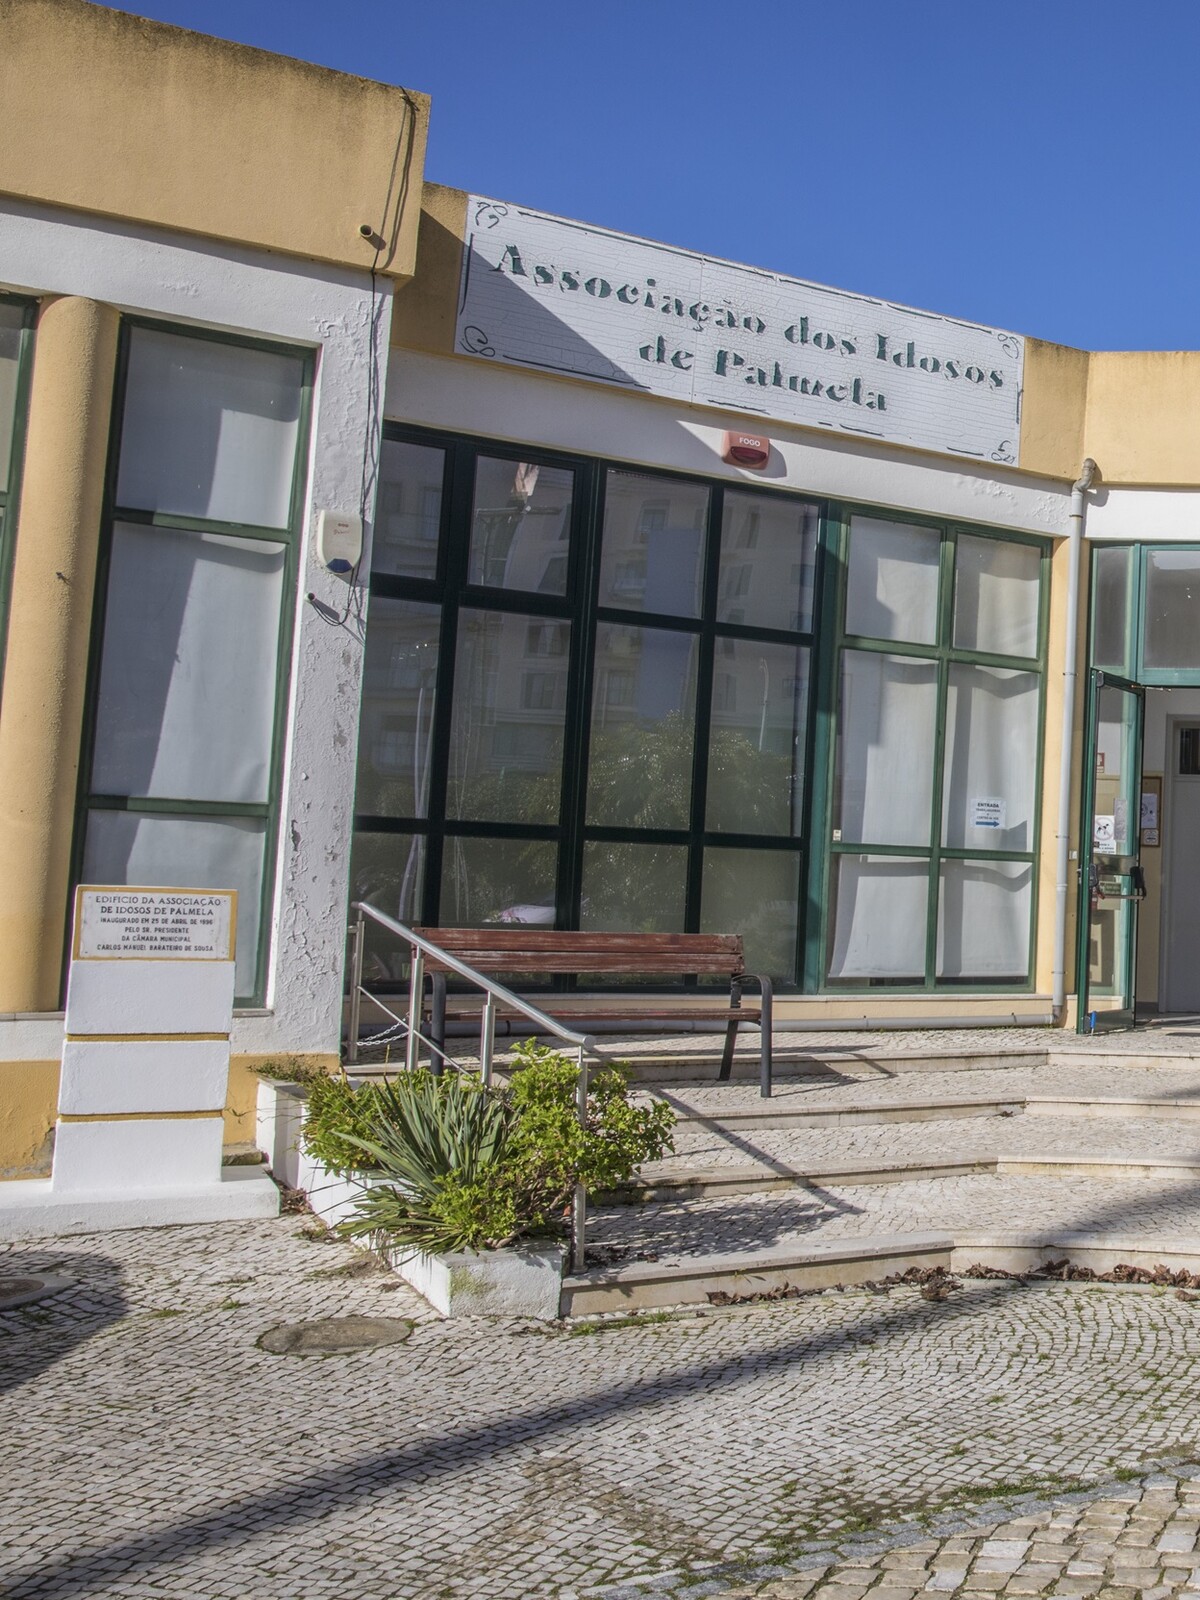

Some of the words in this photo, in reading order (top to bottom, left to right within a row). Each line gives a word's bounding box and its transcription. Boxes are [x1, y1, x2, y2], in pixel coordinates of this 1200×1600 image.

[488, 244, 767, 334] Associação
[784, 316, 857, 356] dos
[876, 333, 1004, 390] Idosos
[638, 334, 694, 371] de
[714, 349, 887, 411] Palmela
[739, 437, 761, 447] FOGO
[95, 896, 139, 904] EDIFICIO
[101, 906, 113, 914] DE
[116, 906, 151, 914] IDOSOS
[154, 907, 167, 915] DE
[170, 907, 214, 916] PALMELA
[132, 934, 158, 942] CÂMARA
